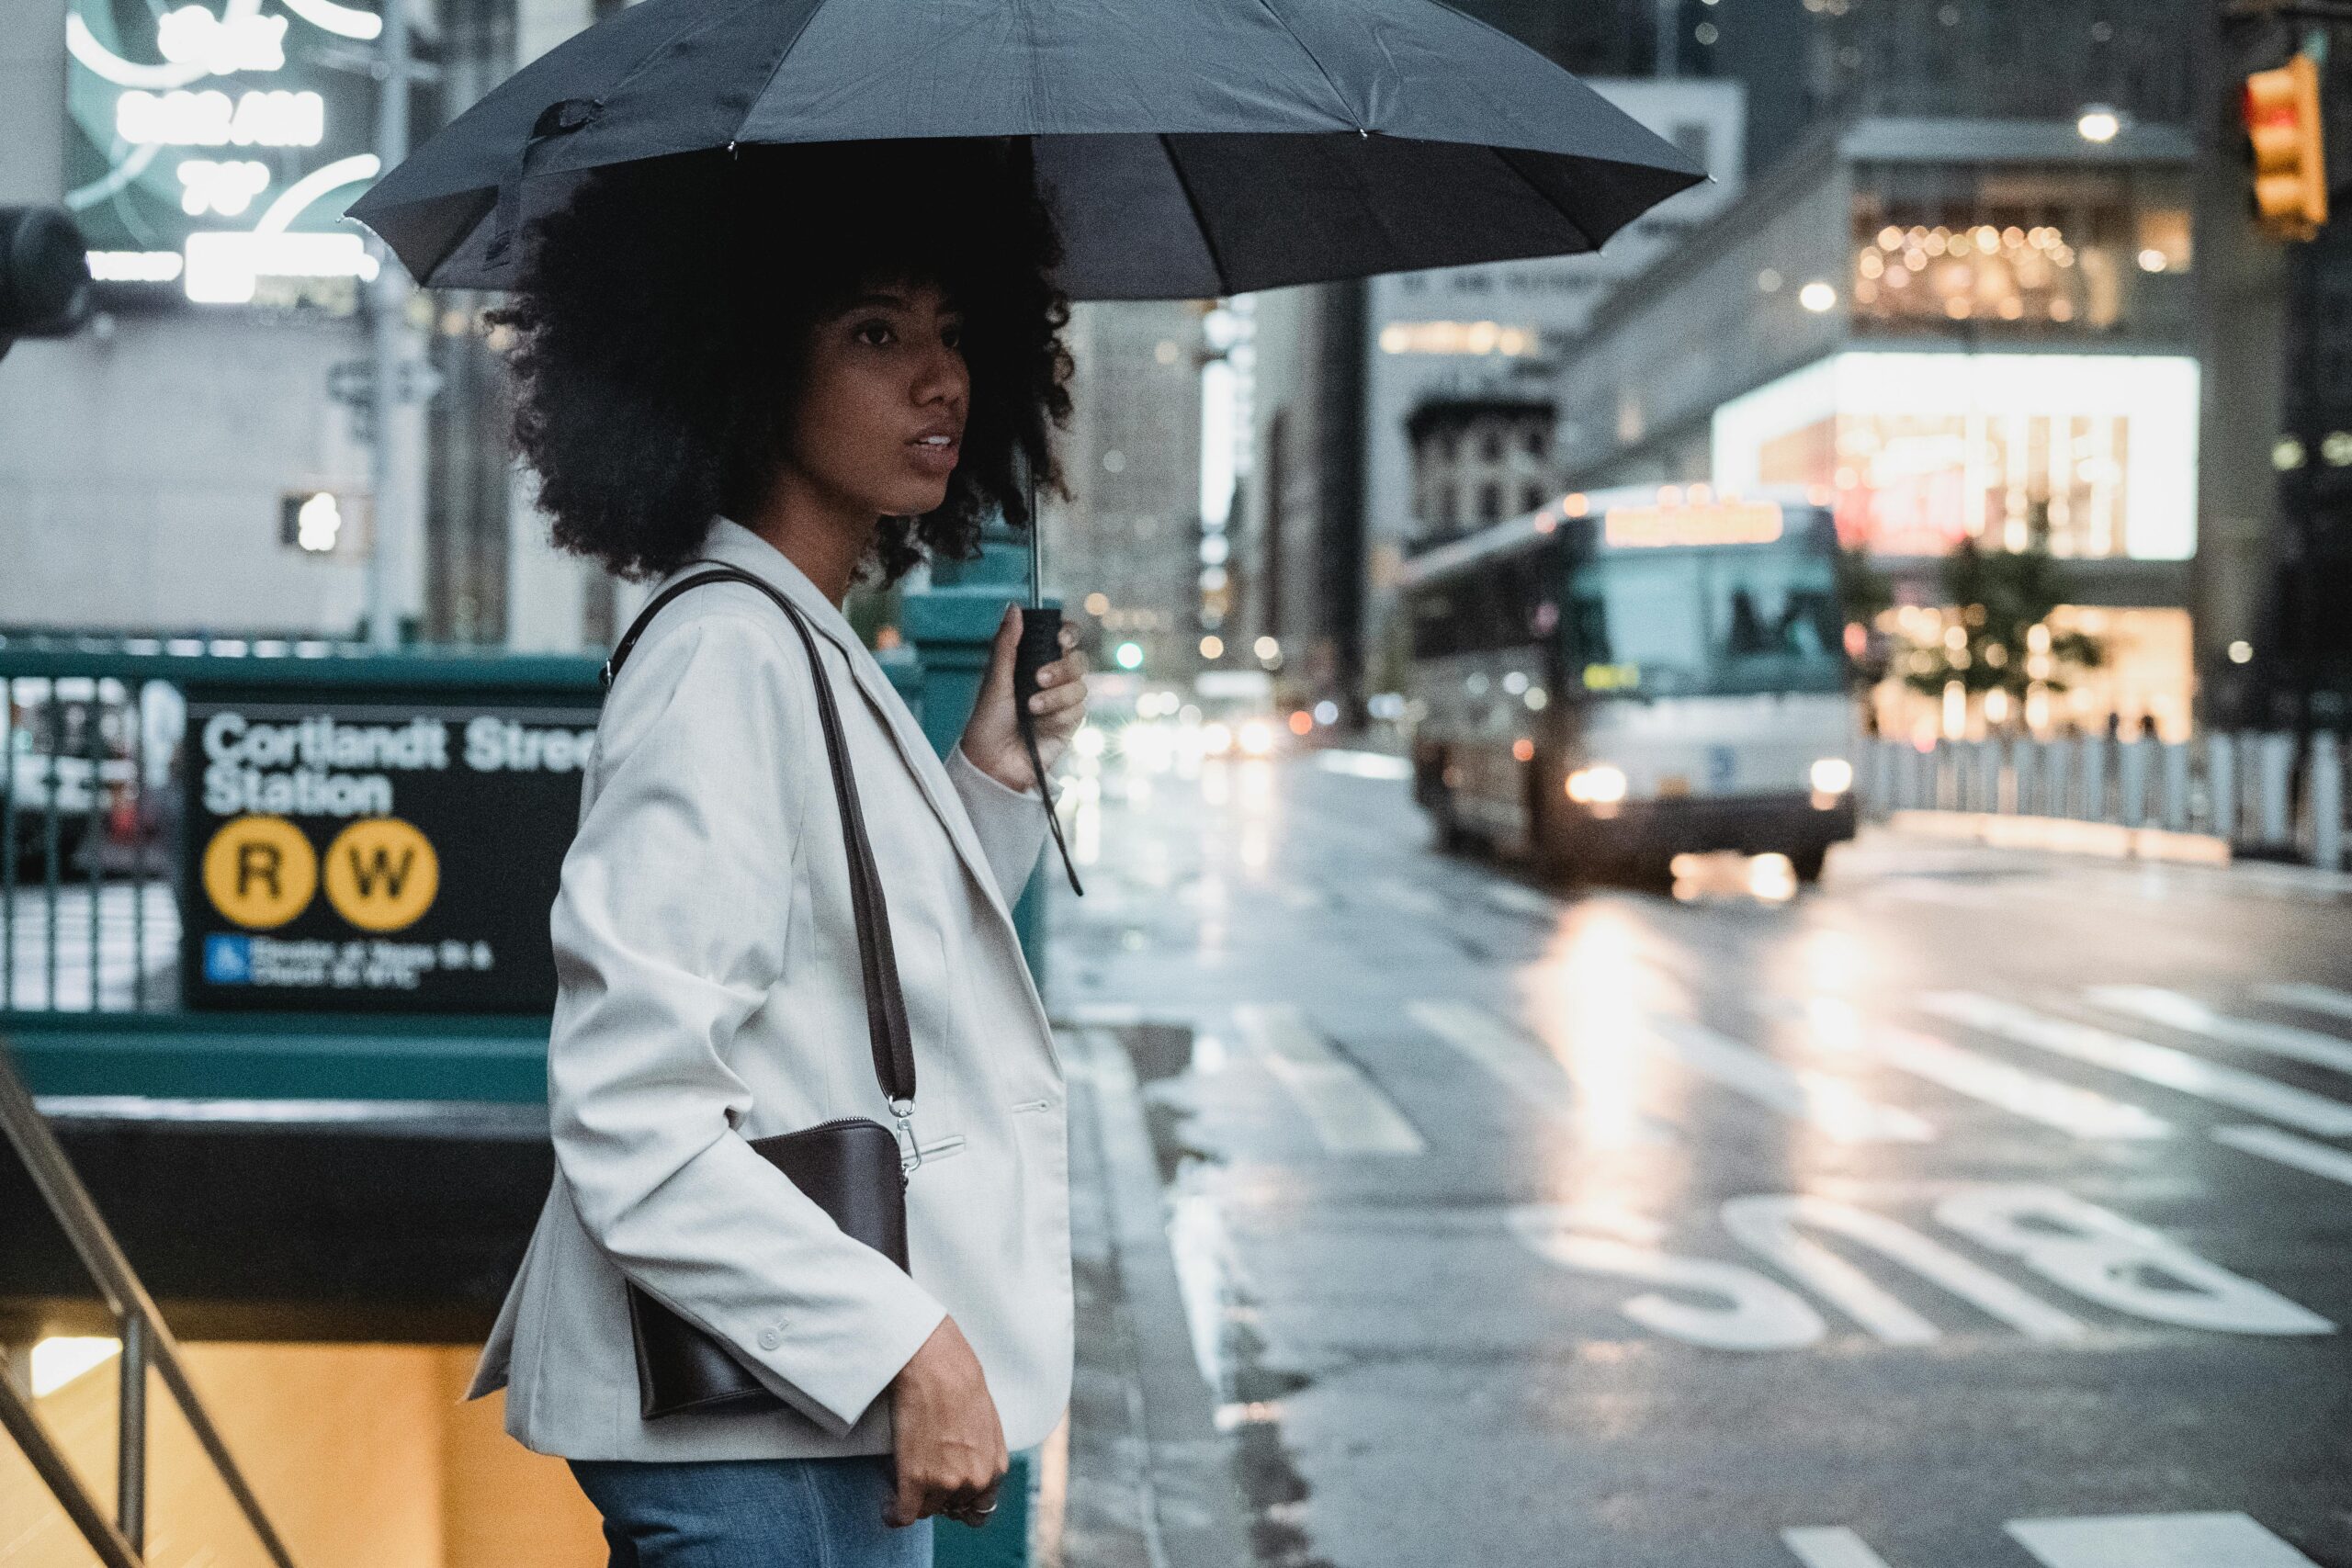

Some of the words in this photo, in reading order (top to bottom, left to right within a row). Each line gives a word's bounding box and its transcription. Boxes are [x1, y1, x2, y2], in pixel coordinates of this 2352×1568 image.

[203, 713, 450, 771] Cortlandt
[203, 761, 393, 816] Station
[236, 841, 283, 899] R
[345, 844, 414, 899] W
[1499, 1183, 2339, 1351] BUS
